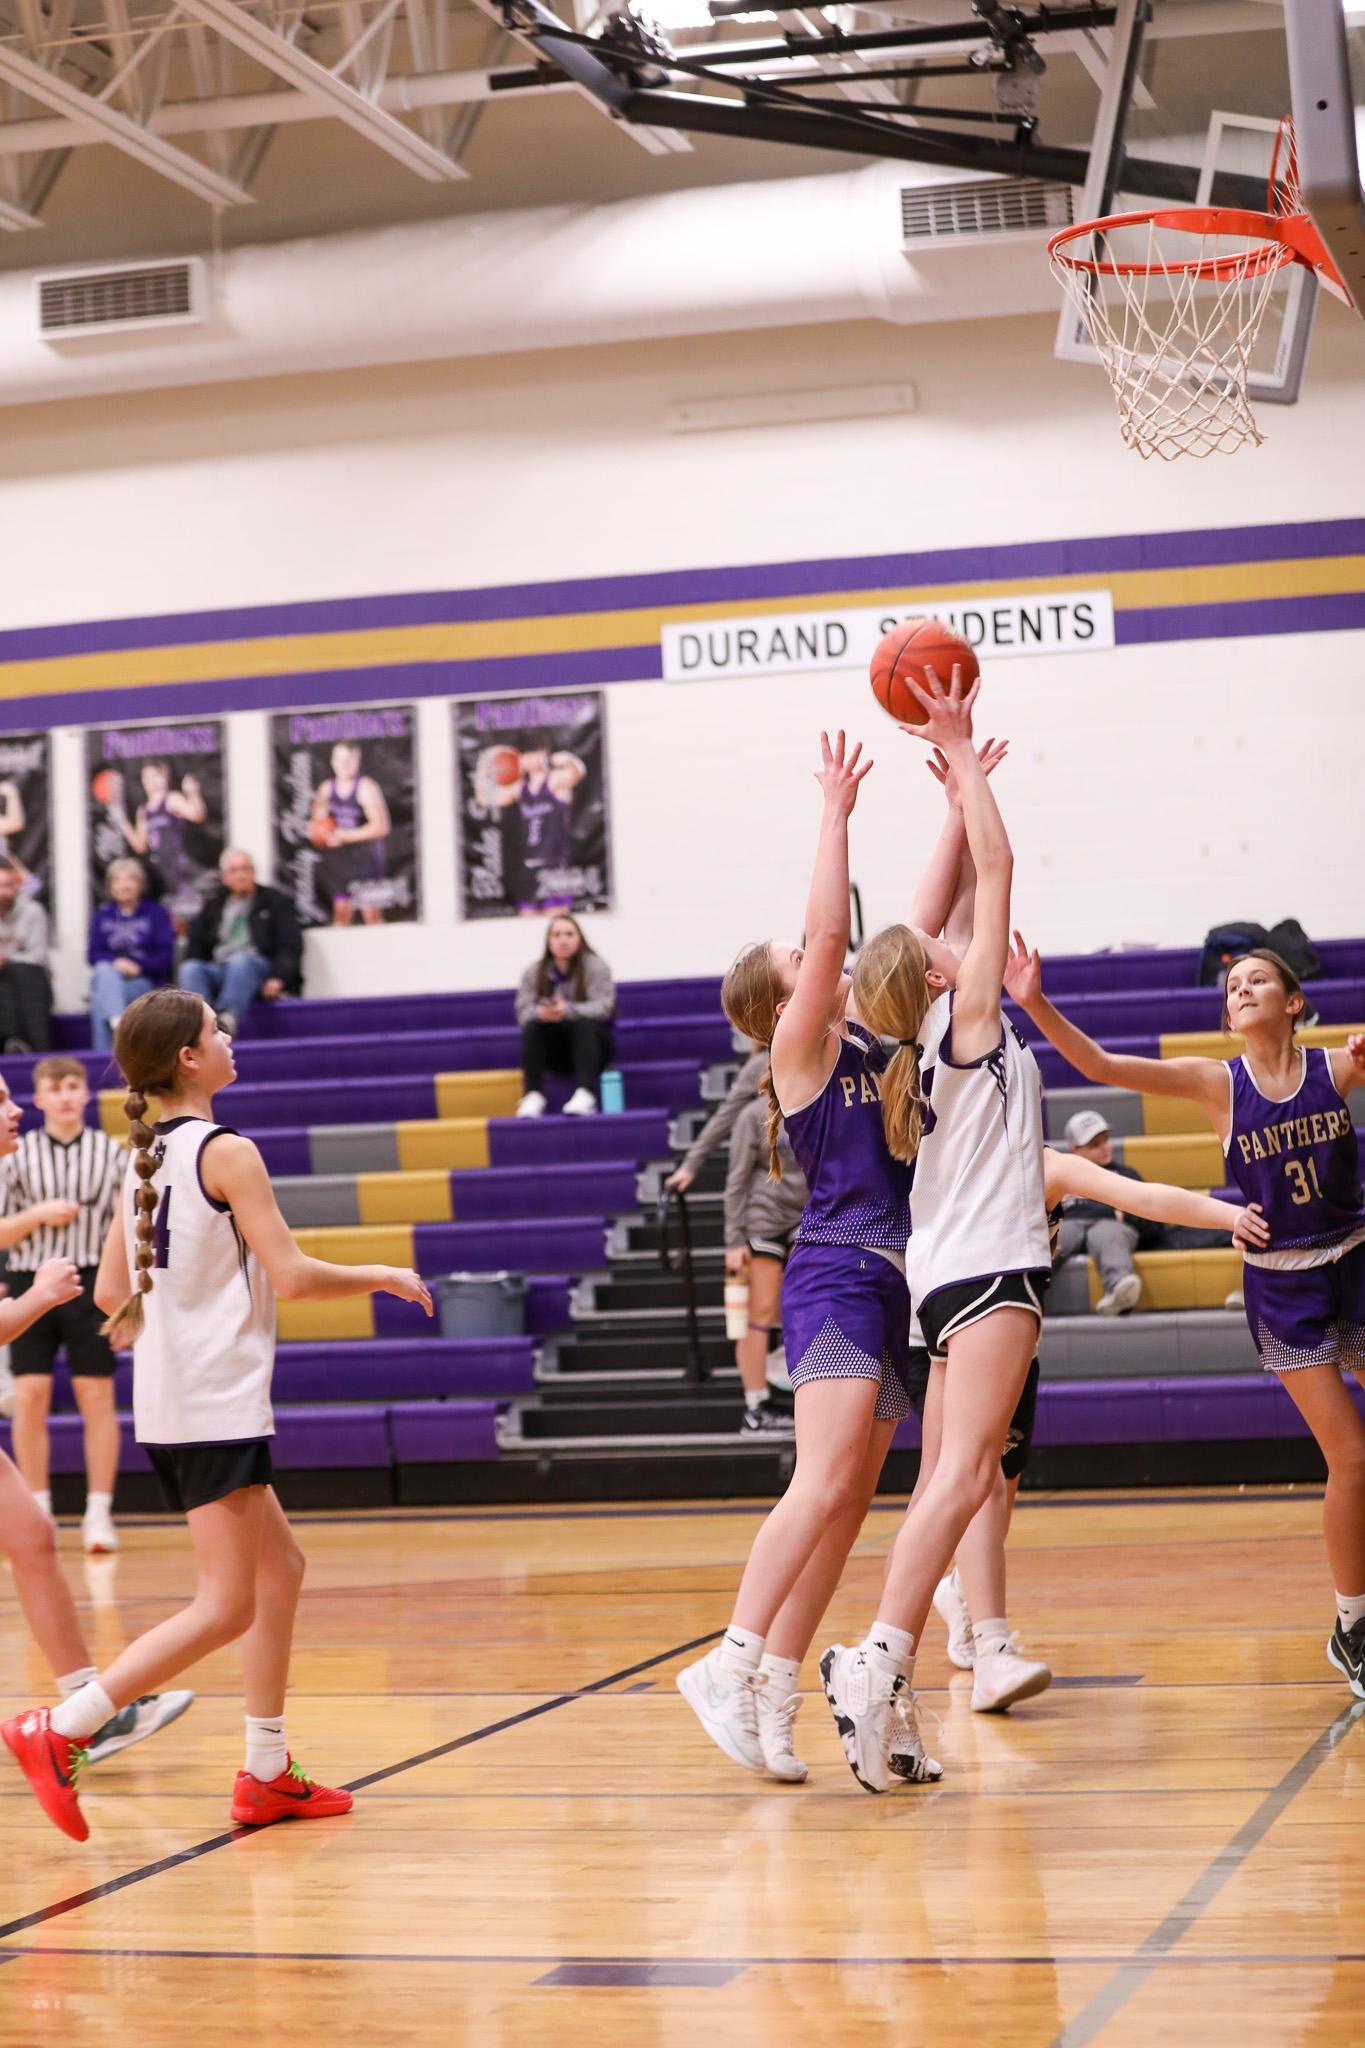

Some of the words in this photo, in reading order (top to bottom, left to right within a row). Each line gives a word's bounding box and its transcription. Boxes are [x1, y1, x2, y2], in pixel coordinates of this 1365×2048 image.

[680, 622, 847, 670] DURAND
[880, 603, 1096, 653] DENTS
[1236, 1107, 1350, 1165] PANTHERS
[1284, 1156, 1324, 1206] 31
